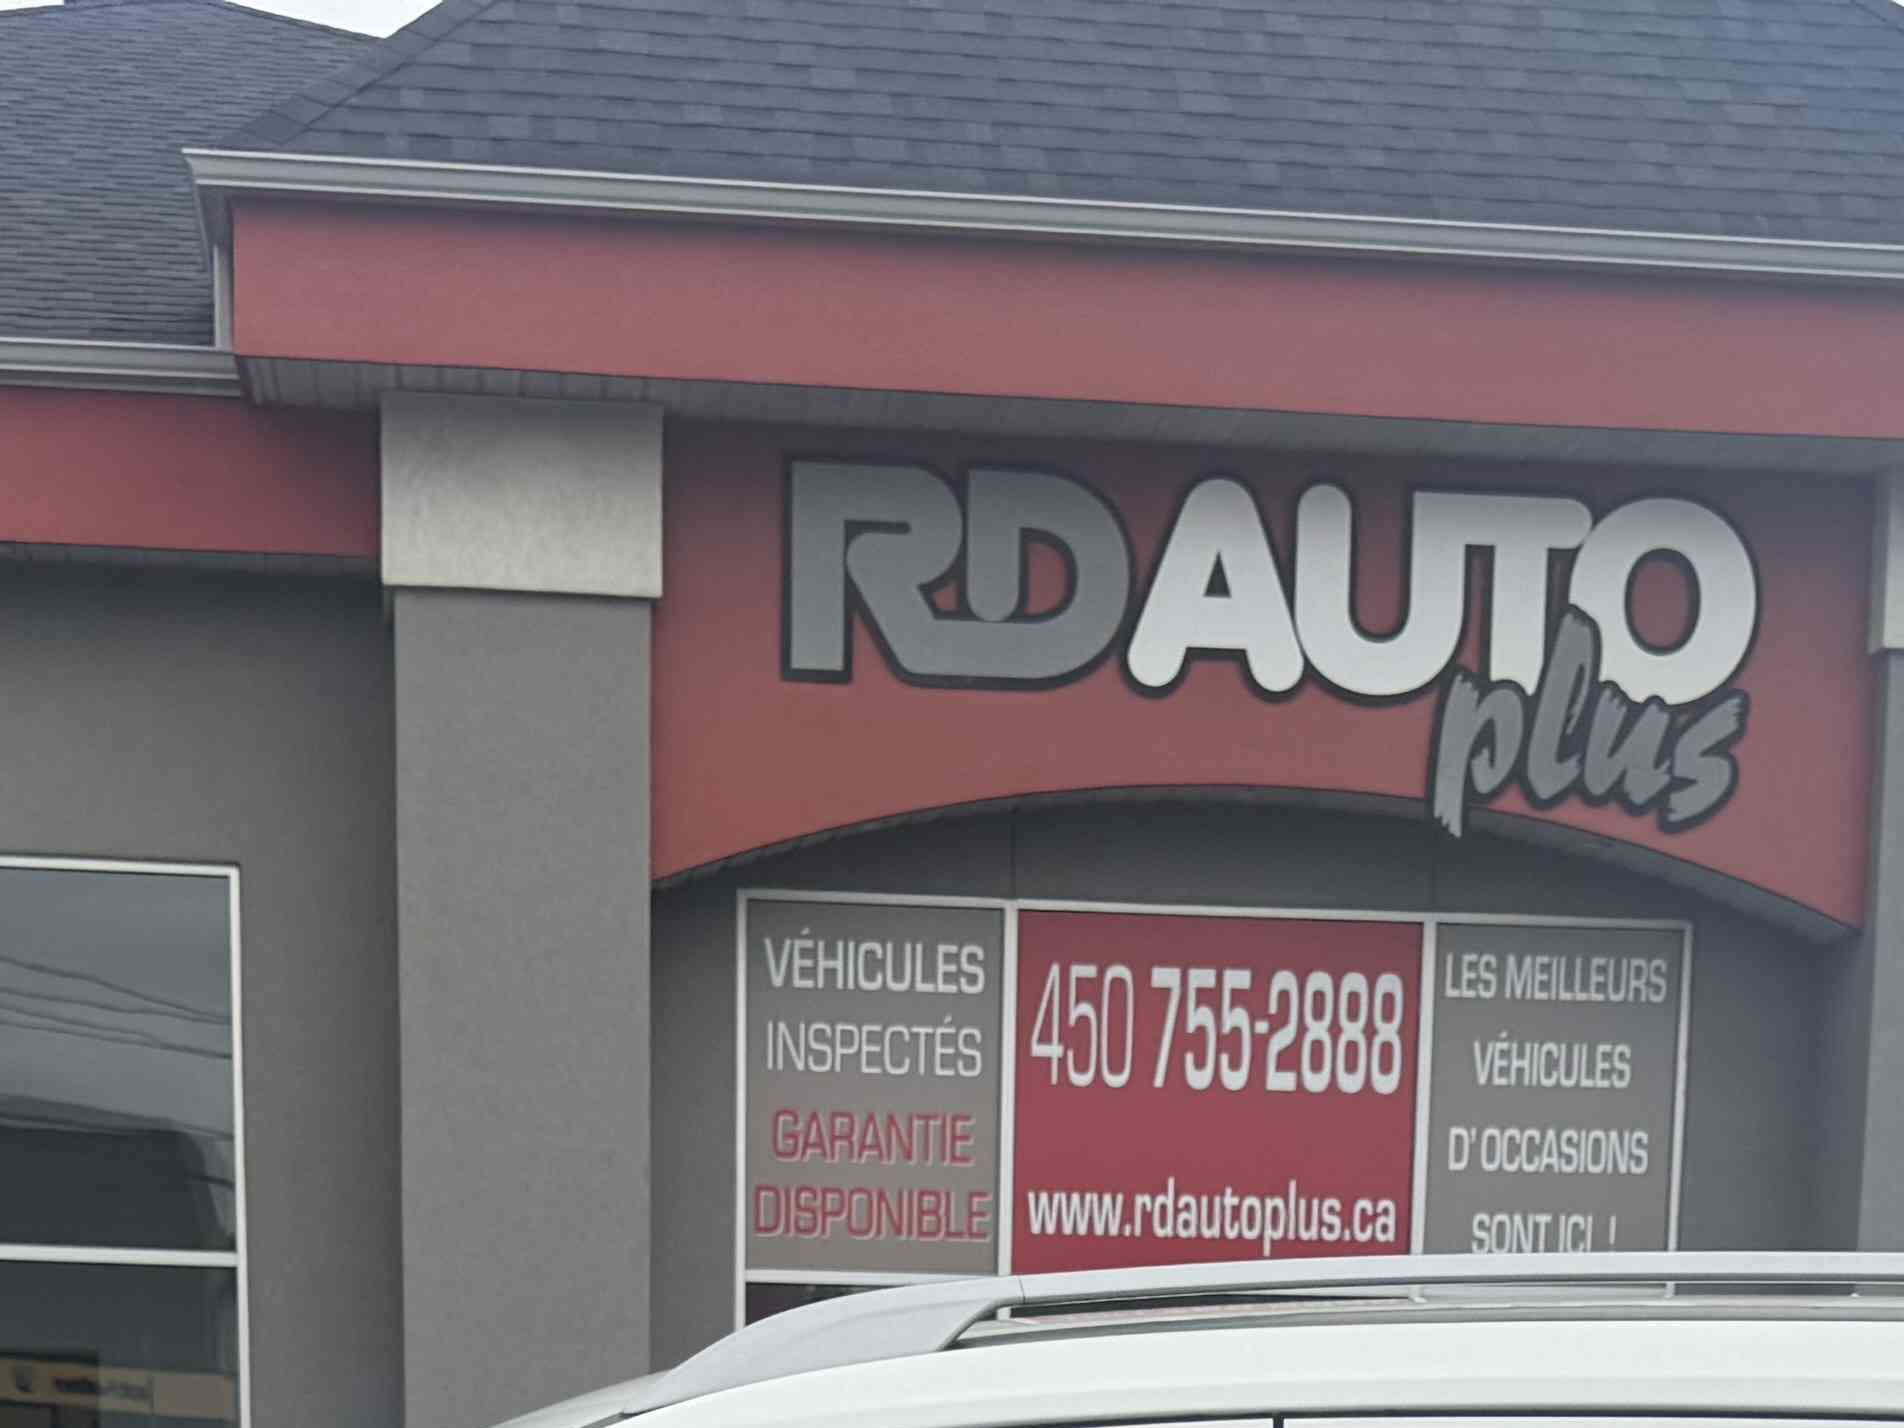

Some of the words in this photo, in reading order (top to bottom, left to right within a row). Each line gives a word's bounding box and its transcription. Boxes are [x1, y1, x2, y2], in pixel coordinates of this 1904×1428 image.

[1432, 609, 1746, 839] plus
[763, 926, 986, 994] VÉHICULES
[1445, 953, 1497, 999] LES
[1504, 954, 1668, 1003] MEILLEURS
[766, 1014, 984, 1077] INSPECTÉS
[1030, 962, 1135, 1089] 450
[1150, 964, 1404, 1095] 755-2888
[1473, 1029, 1632, 1089] VÉHICULES
[771, 1108, 977, 1168] GARANTIE
[752, 1183, 993, 1242] DISPONIBLE
[1027, 1176, 1397, 1257] www.rdautoplus.ca
[1471, 1213, 1552, 1254] SONT
